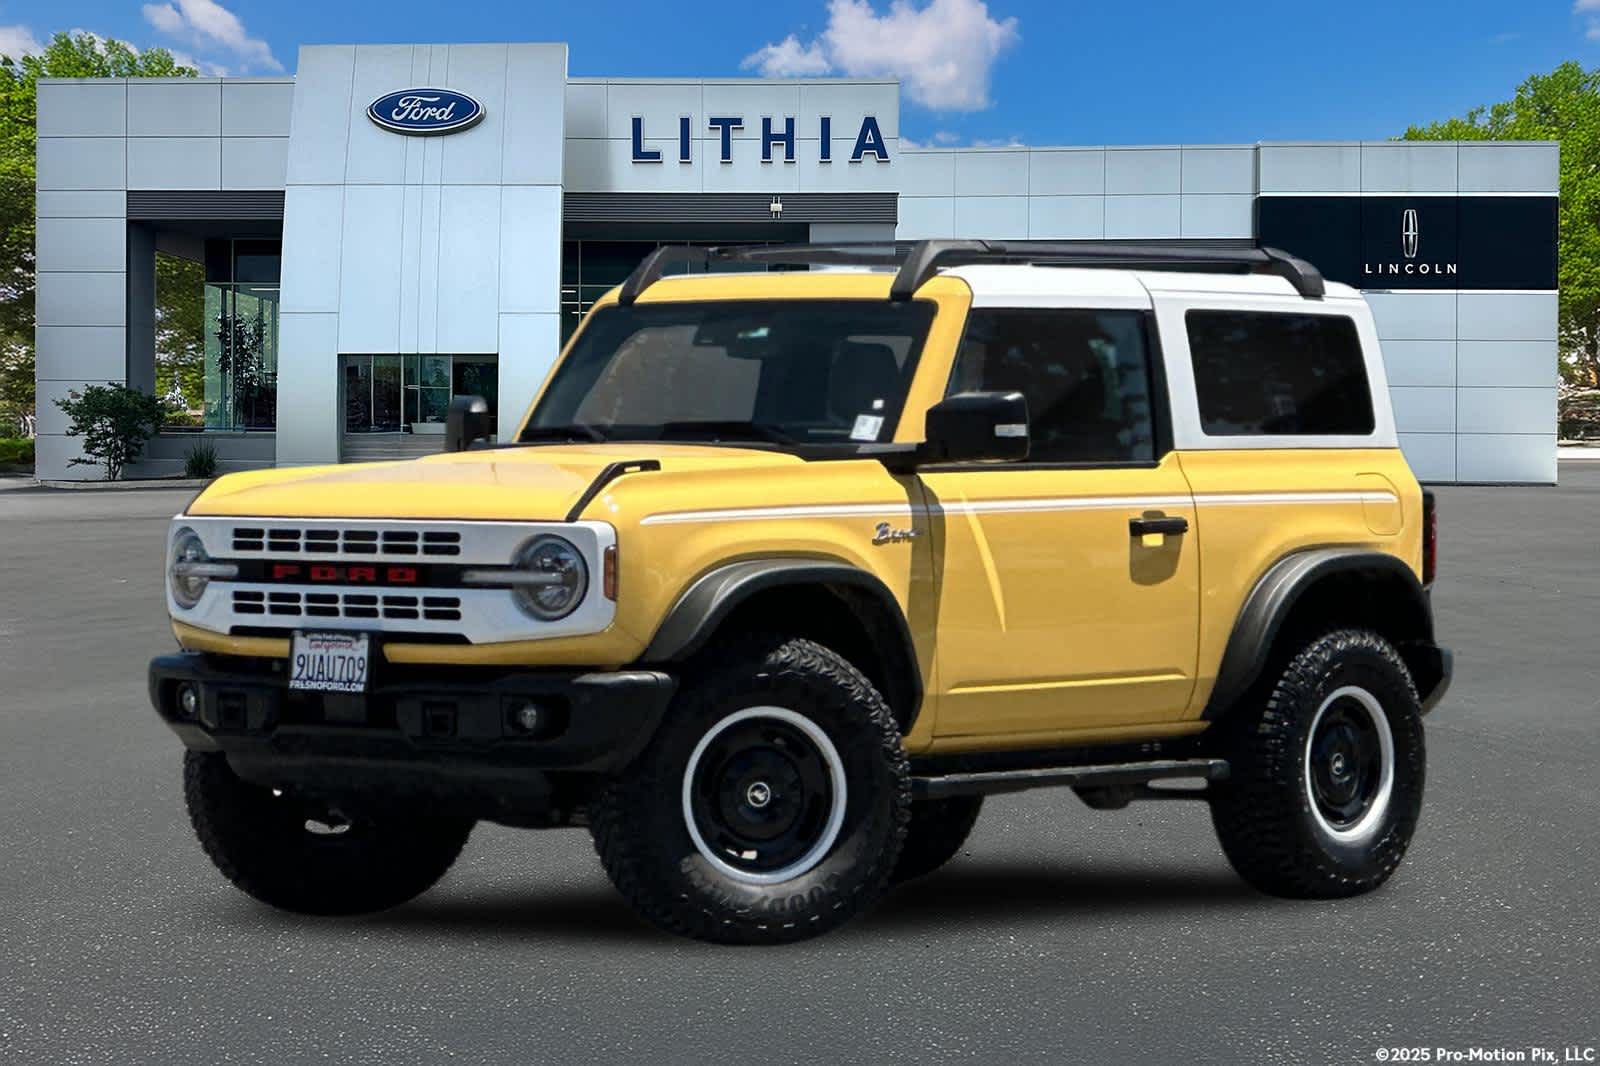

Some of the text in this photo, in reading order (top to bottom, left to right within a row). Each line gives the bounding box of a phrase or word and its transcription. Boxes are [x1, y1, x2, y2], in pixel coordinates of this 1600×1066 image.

[391, 95, 456, 121] Ford
[631, 116, 890, 163] LITHIA
[1364, 263, 1457, 274] LINCOLN
[273, 564, 417, 583] FORD
[295, 653, 366, 682] 9UAU709
